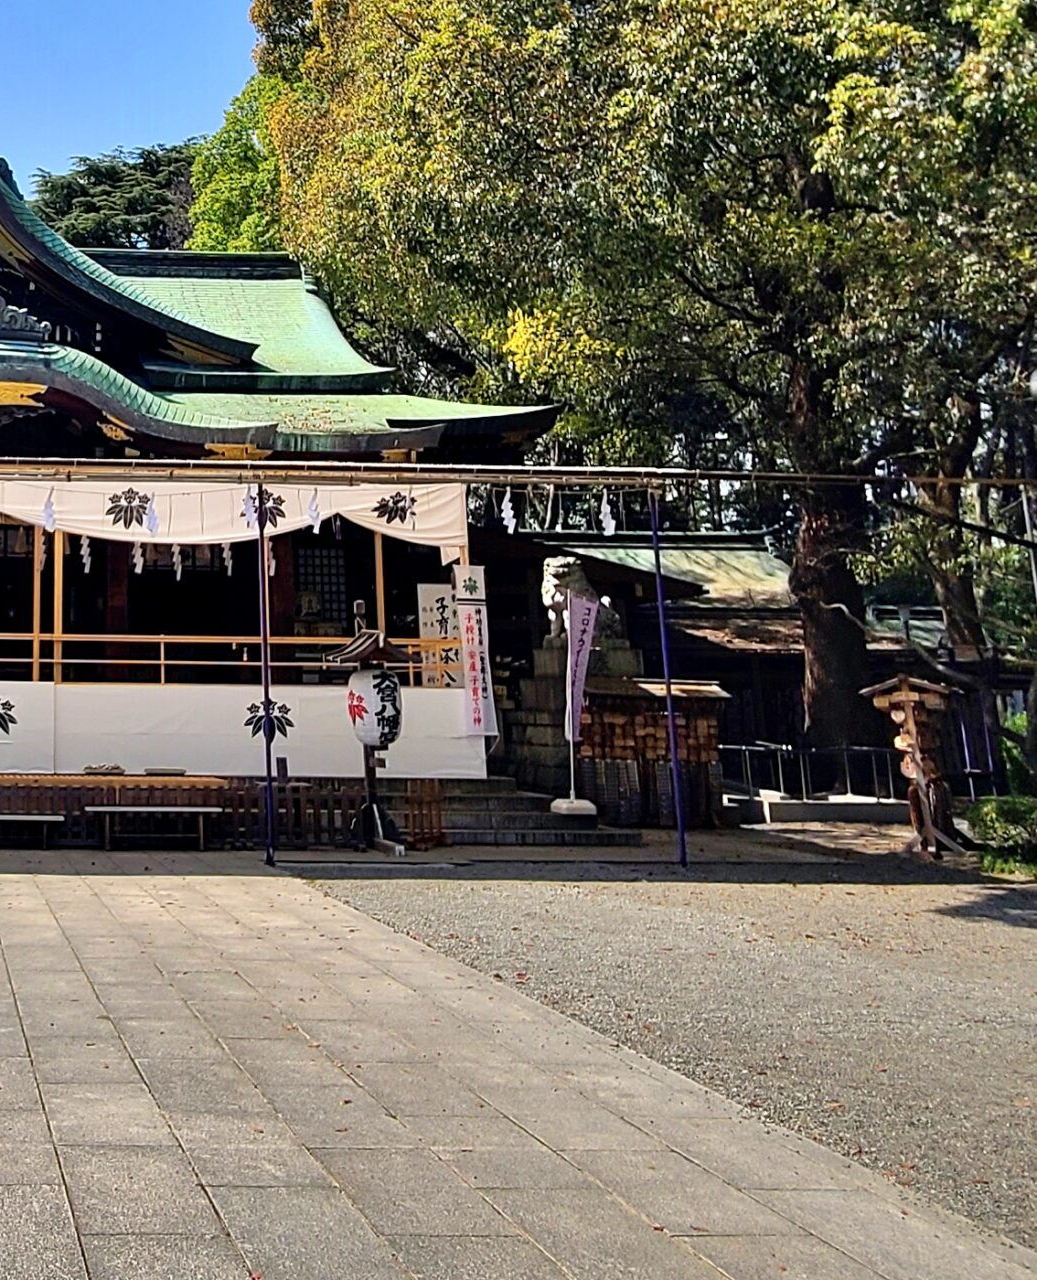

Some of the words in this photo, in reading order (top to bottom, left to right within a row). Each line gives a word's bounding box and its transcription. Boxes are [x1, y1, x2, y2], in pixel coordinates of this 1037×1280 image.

[372, 671, 401, 745] 大宮八幡宮
